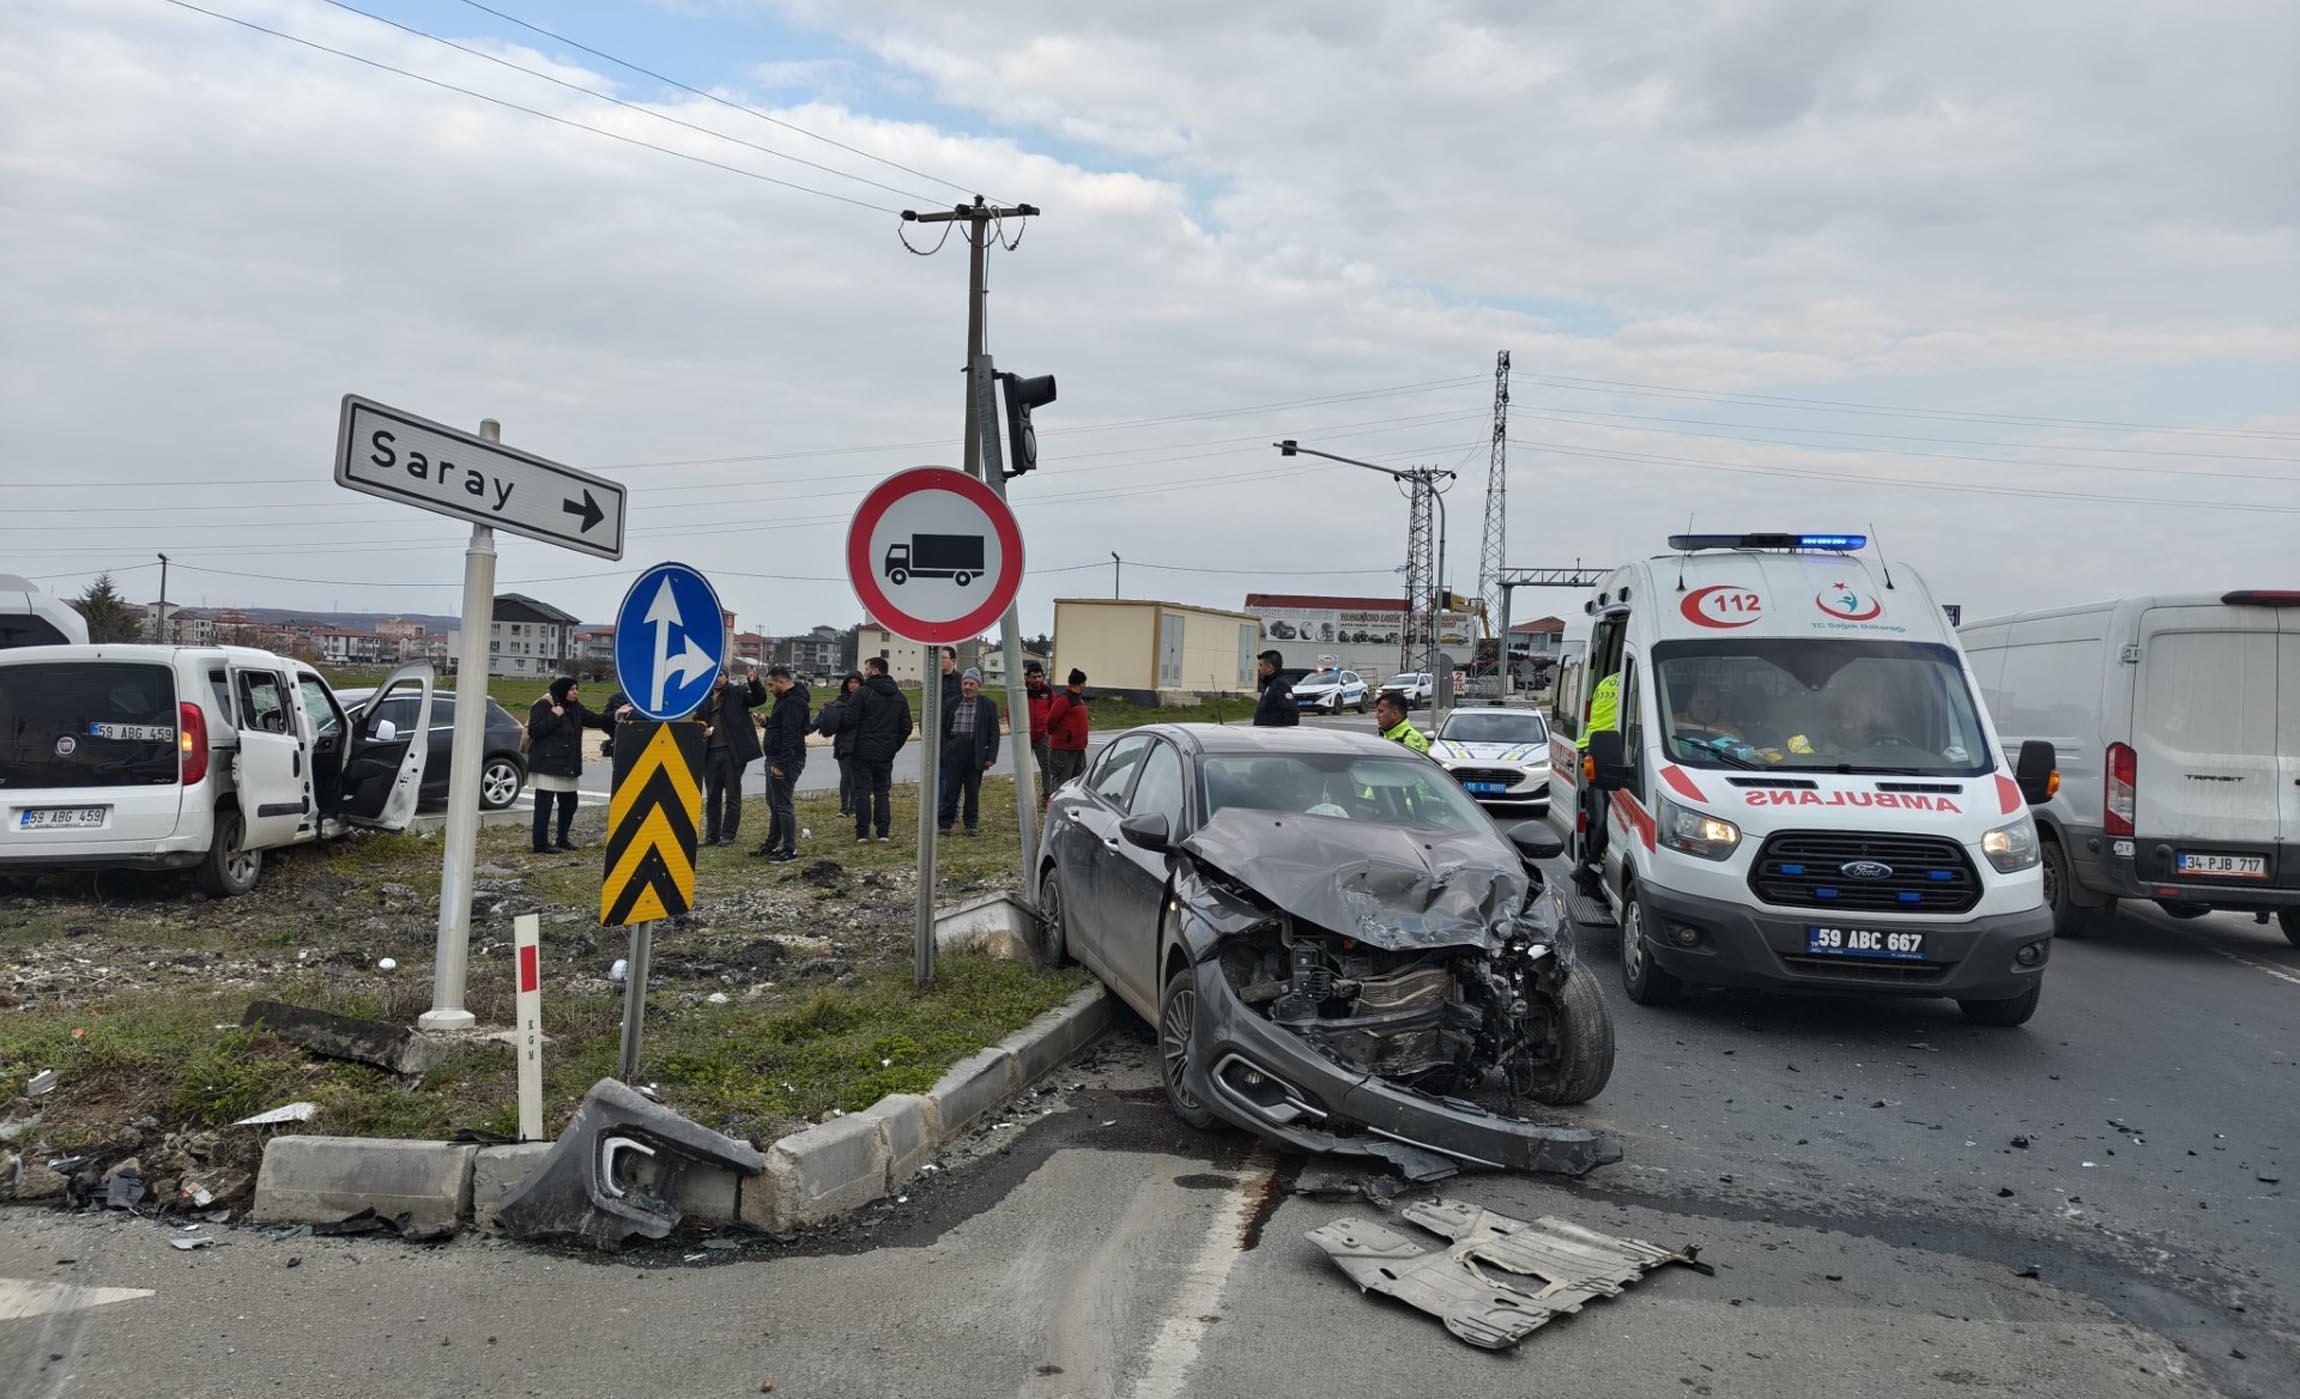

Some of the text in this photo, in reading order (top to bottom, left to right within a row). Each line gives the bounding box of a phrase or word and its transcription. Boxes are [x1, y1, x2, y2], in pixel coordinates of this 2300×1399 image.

[370, 430, 514, 512] Saray
[1714, 594, 1761, 612] 112
[99, 726, 172, 741] 59 ABG 459
[2185, 774, 2245, 783] TRANSIT
[29, 810, 101, 824] 59 ABG 459
[1854, 864, 1881, 877] Ford
[2187, 856, 2261, 872] 34 PJB 717
[1819, 928, 1922, 952] 59 ABC 667
